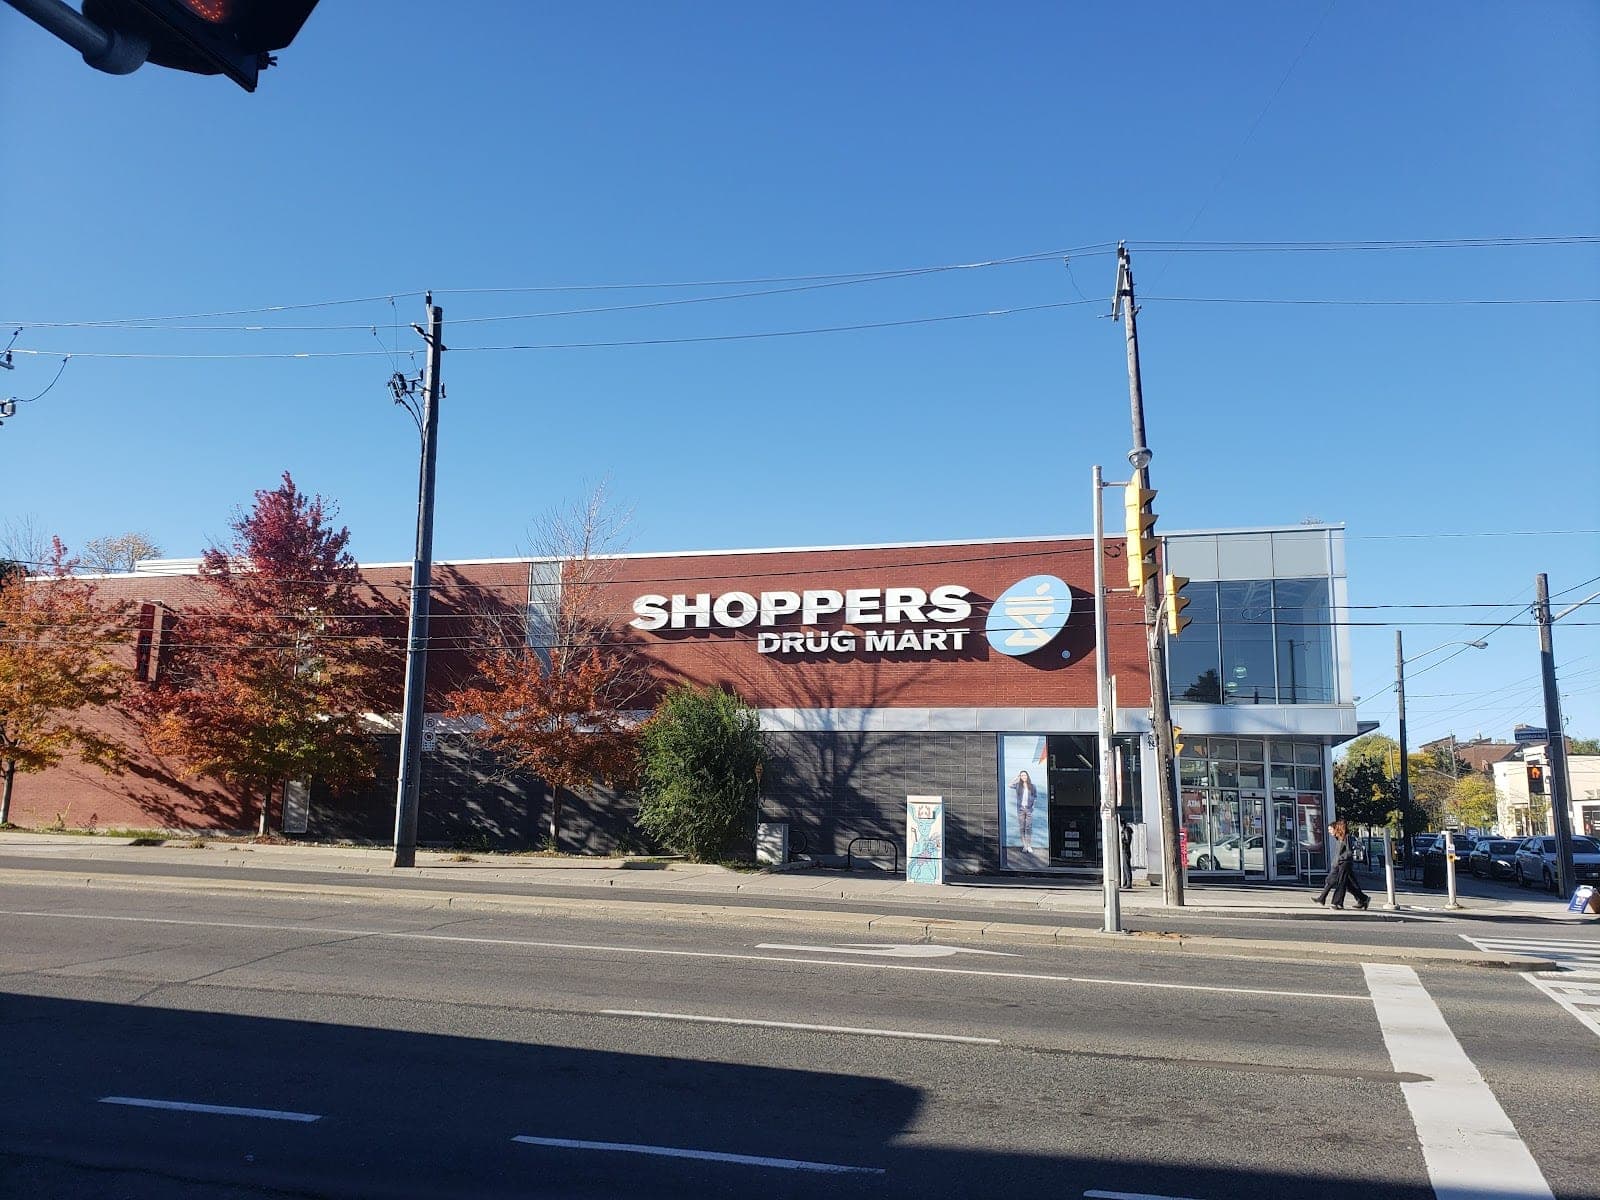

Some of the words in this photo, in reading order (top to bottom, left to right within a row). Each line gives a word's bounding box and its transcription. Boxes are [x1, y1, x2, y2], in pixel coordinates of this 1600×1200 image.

[629, 585, 972, 630] SHOPPERS
[757, 631, 856, 654] DRUG
[864, 628, 970, 653] MART
